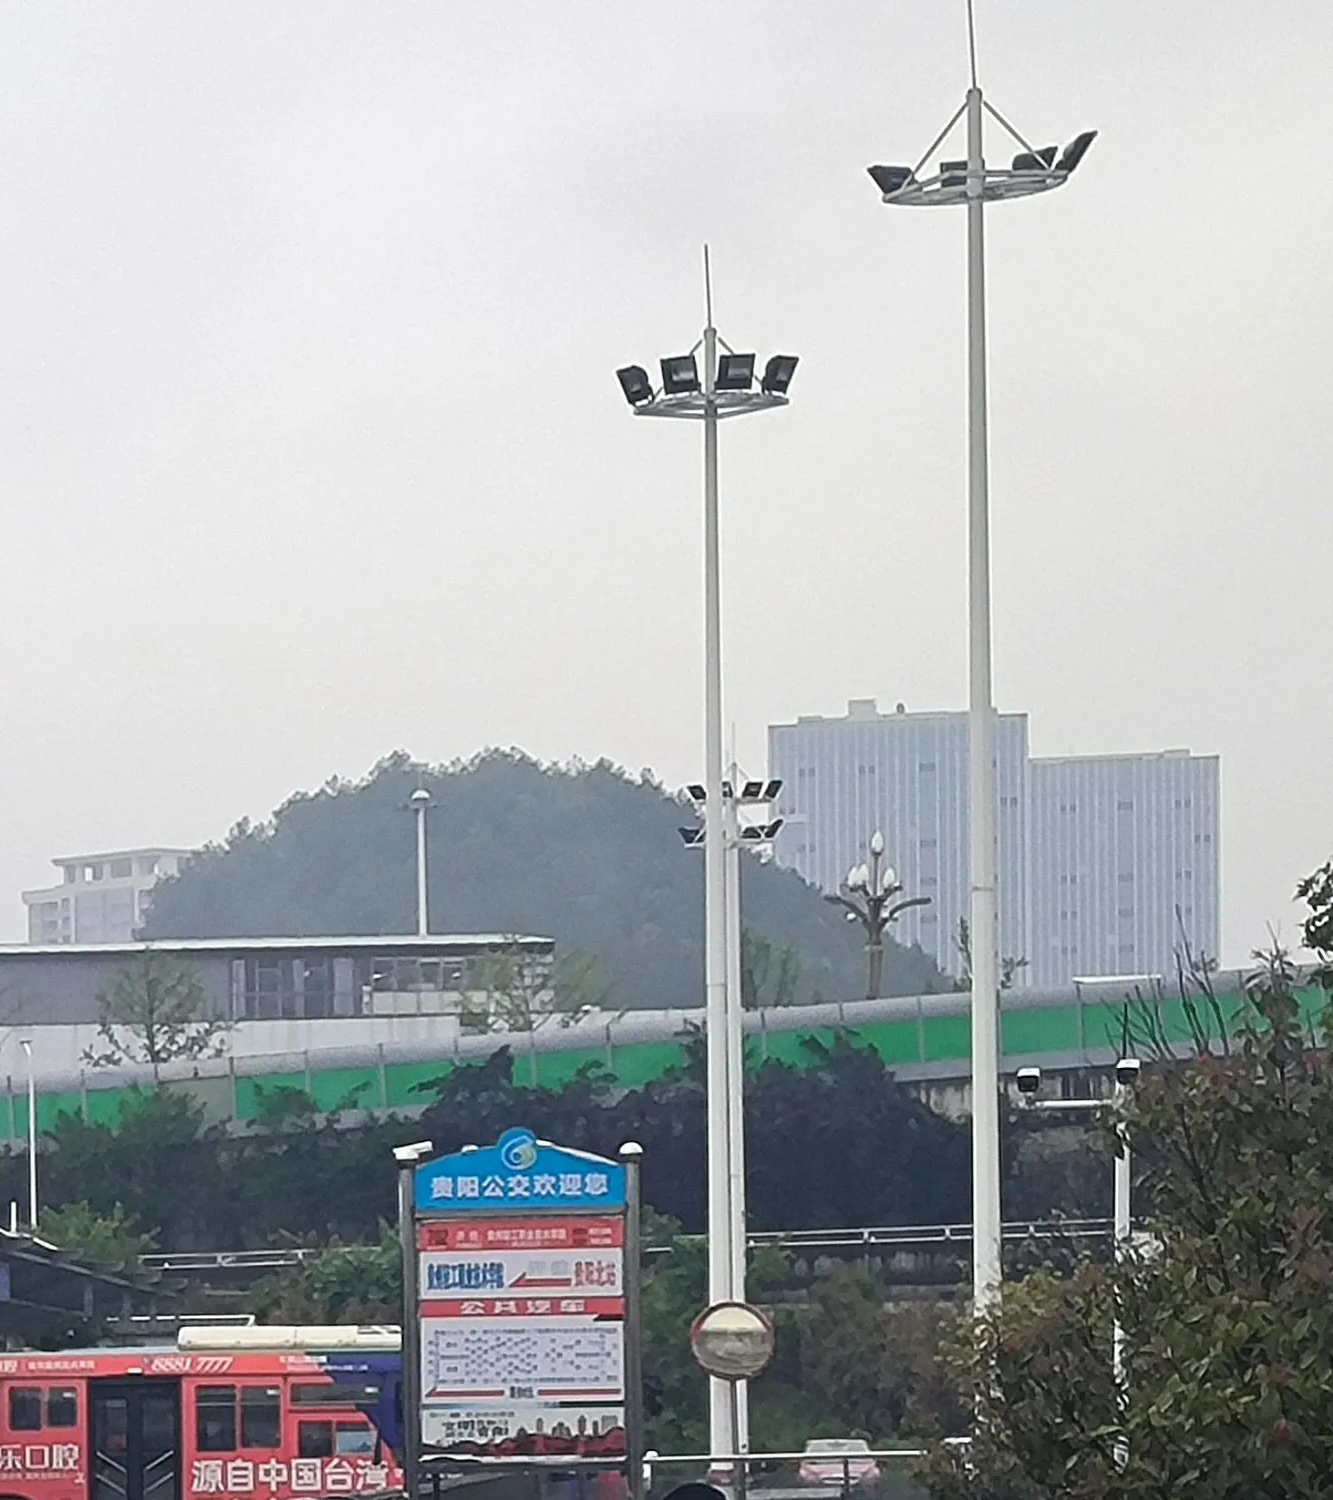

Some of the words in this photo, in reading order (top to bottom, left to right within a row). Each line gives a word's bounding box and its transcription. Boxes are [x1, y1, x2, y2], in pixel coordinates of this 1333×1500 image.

[429, 1173, 609, 1199] 贵阳公交欢迎您
